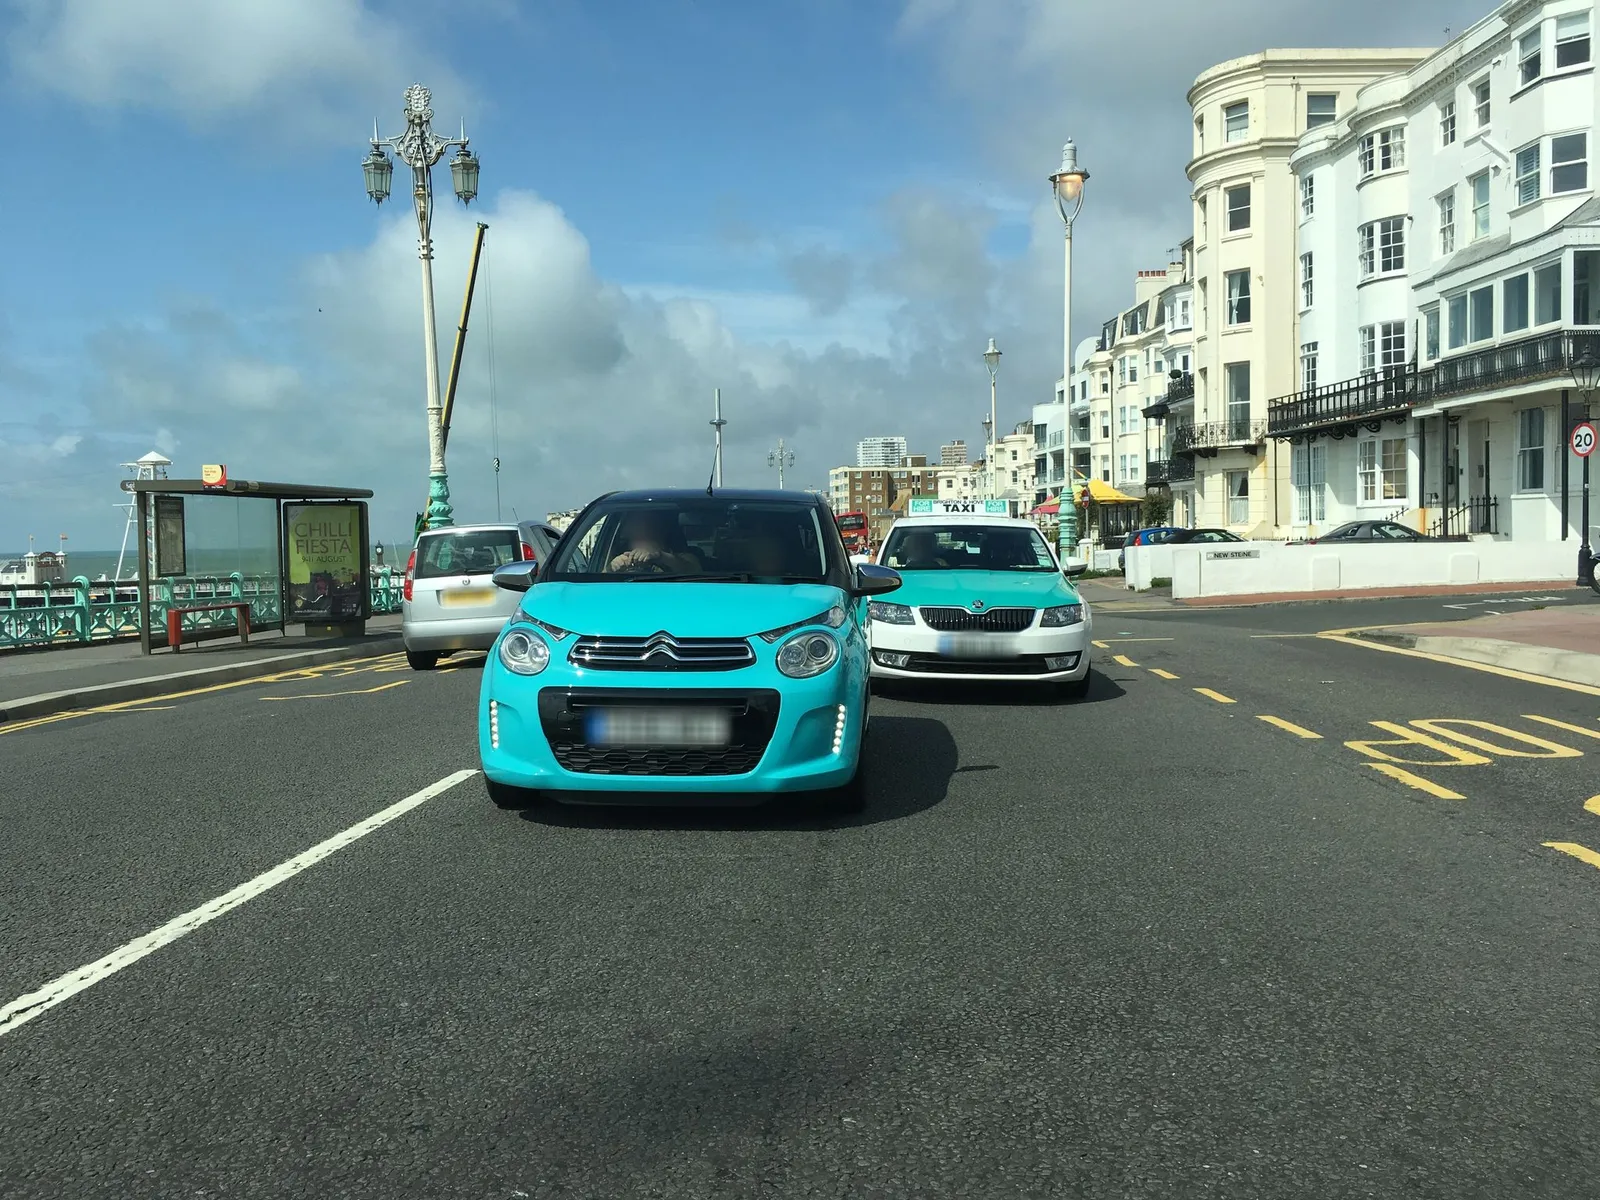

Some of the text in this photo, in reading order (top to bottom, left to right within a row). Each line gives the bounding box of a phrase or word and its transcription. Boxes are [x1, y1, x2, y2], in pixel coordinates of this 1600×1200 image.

[1575, 433, 1593, 447] 20
[943, 504, 975, 513] TAXI
[294, 522, 352, 538] CHILLI
[296, 539, 352, 554] FIESTA
[316, 555, 346, 563] AUGUST
